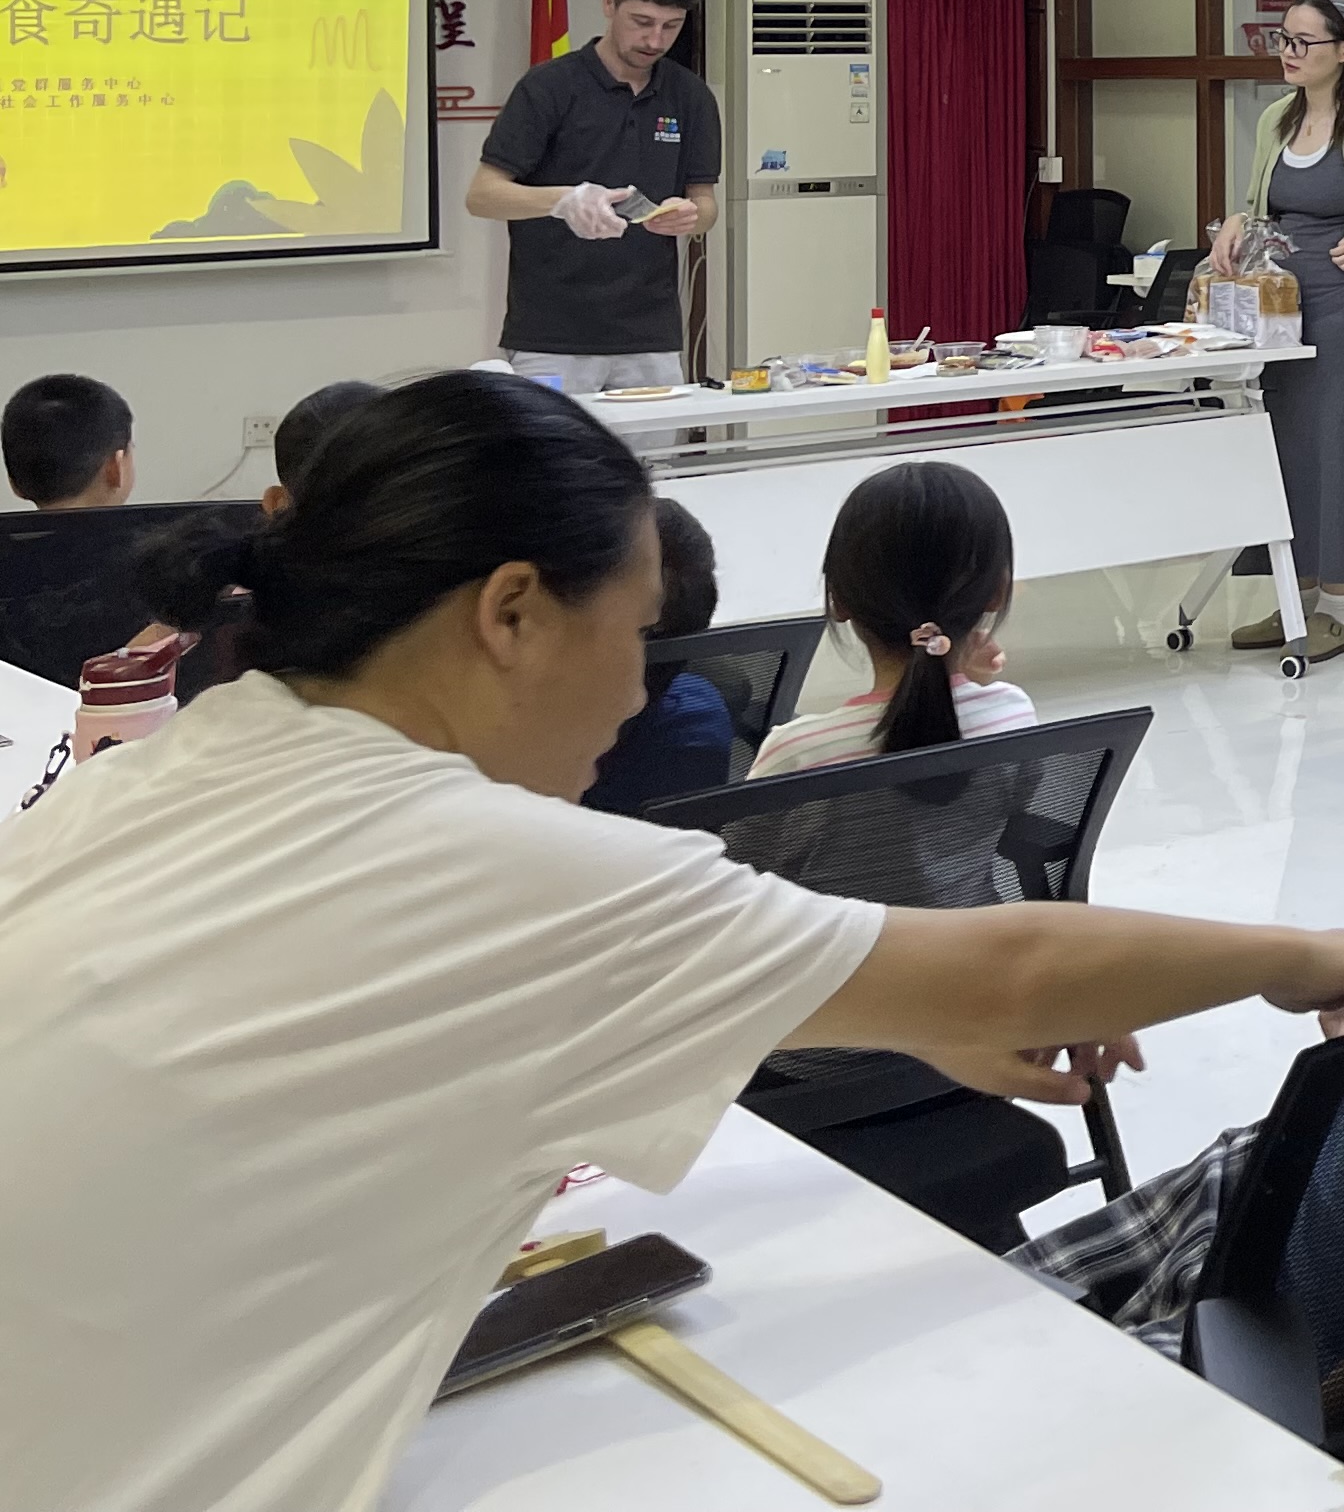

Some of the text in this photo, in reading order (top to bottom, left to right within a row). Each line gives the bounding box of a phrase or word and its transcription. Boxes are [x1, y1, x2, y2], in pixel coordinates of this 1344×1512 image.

[0, 77, 142, 92] 党群服务中心
